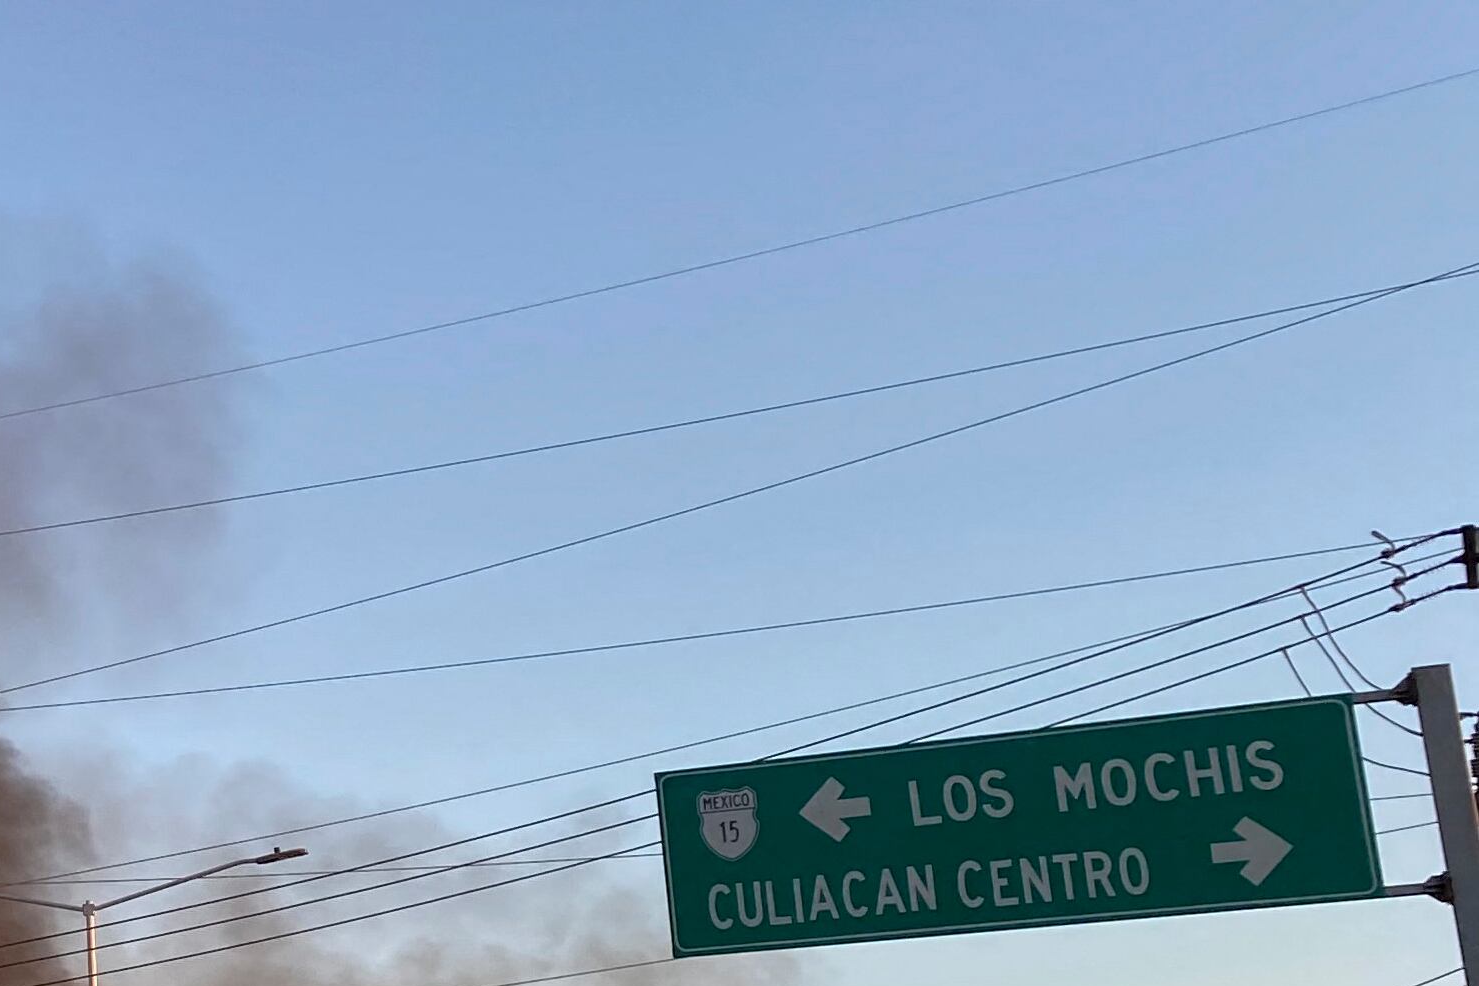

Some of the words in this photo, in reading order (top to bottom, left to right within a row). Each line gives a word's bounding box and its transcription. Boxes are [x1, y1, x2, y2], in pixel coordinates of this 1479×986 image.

[702, 792, 751, 811] MEXICO
[908, 769, 1015, 826] LOS
[1052, 740, 1285, 812] MOCHIS
[719, 819, 740, 844] 15
[707, 863, 938, 930] CULIACAN
[956, 846, 1151, 909] CENTRO
